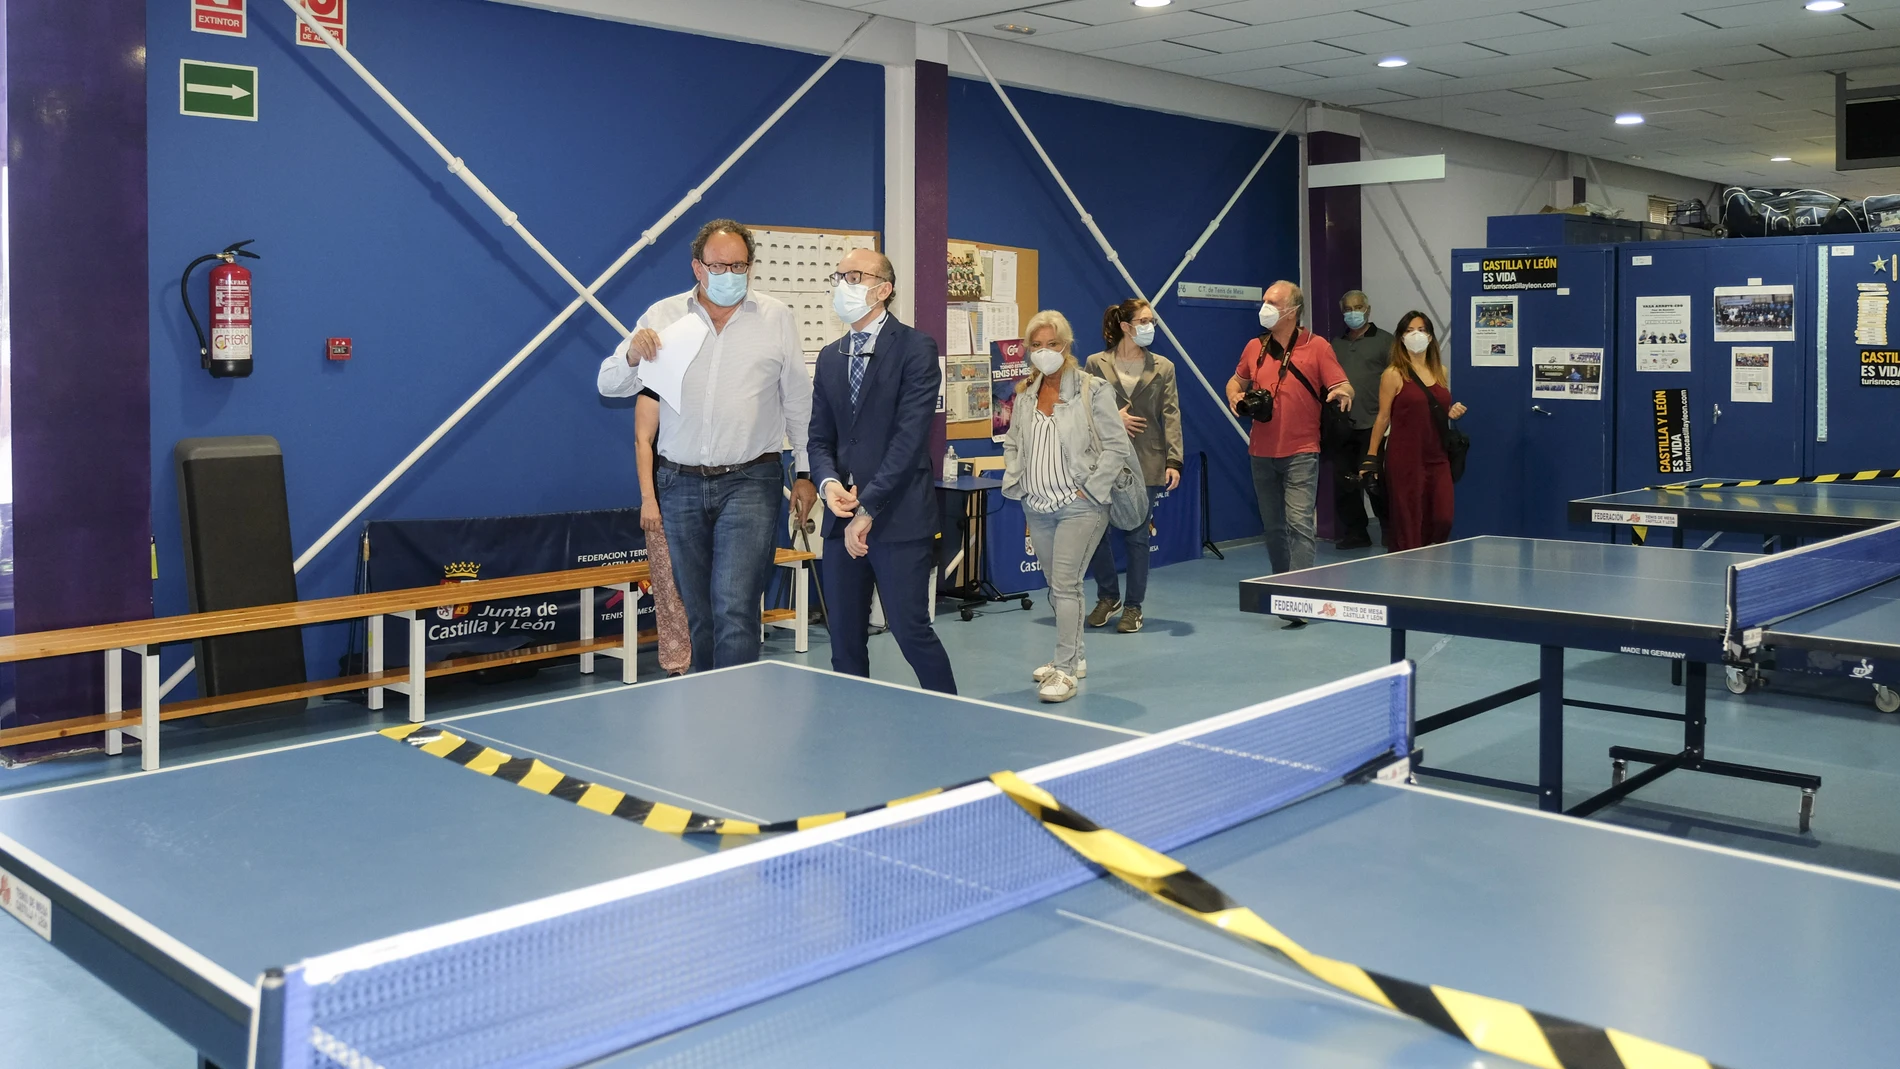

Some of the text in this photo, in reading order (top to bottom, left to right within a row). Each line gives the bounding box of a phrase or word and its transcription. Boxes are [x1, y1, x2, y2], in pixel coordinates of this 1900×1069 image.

[198, 15, 240, 27] EXTINTOR
[302, 33, 312, 41] DE
[1483, 260, 1523, 271] CASTILLA
[1525, 259, 1532, 270] Y
[1533, 257, 1557, 269] LEÓN
[1483, 271, 1516, 283] ES VIDA
[1483, 282, 1556, 291] turismocastillayleon.com
[992, 369, 1010, 379] TENIS
[1011, 368, 1019, 377] DE
[1861, 365, 1876, 377] ES
[1861, 378, 1900, 386] turismoca
[1653, 391, 1667, 416] LEÓN
[1681, 389, 1692, 472] turismocastillayleon.com
[1658, 427, 1671, 473] CASTILLA
[1670, 433, 1684, 472] ES VIDA
[1594, 511, 1623, 522] FEDERACIÓN
[577, 551, 627, 563] FEDERACION
[1020, 560, 1042, 573] Cast
[478, 601, 558, 618] Junta de
[1274, 599, 1313, 614] FEDERACIÓN
[1342, 605, 1358, 613] TENIS
[601, 611, 623, 621] TENIS
[1342, 611, 1365, 620] CASTILLA
[428, 618, 556, 641] Castilla y León
[1620, 646, 1686, 659] MADE IN GERMANY
